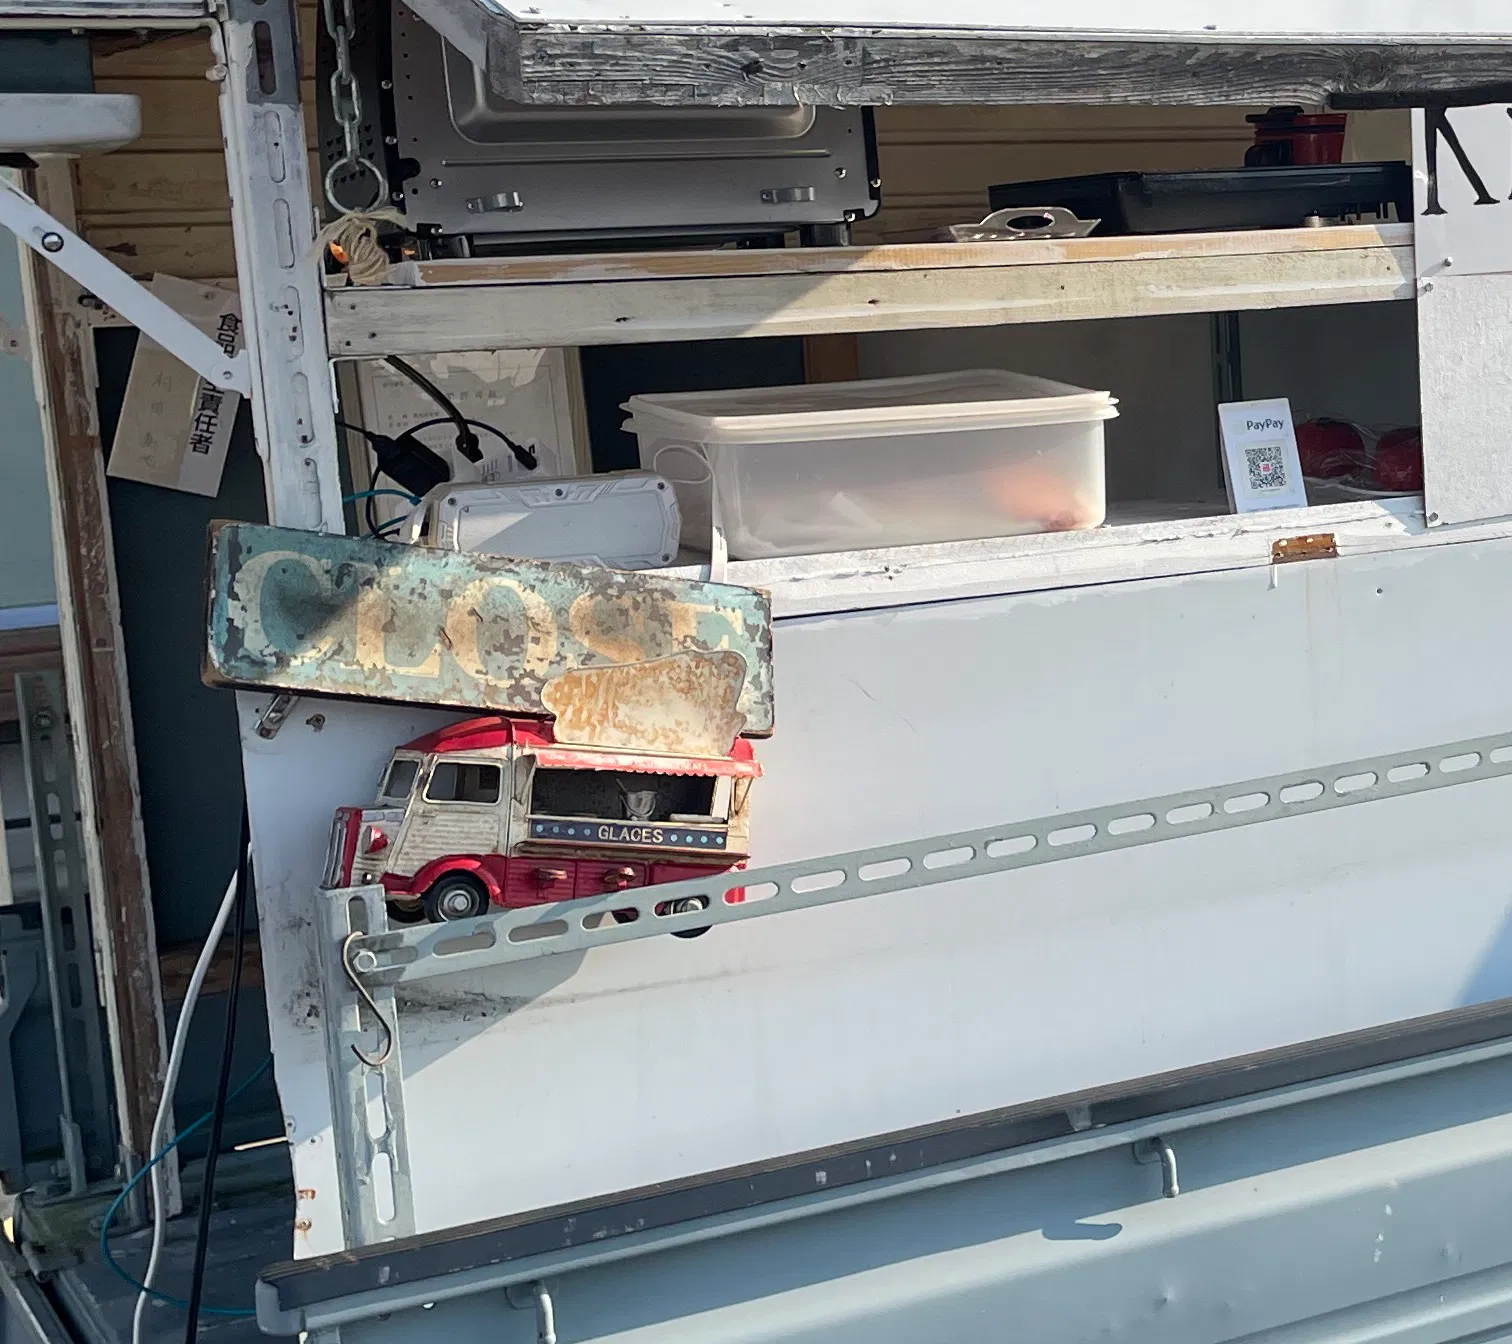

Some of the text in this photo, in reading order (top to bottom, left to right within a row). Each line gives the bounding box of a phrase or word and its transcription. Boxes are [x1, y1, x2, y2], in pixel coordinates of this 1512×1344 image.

[189, 312, 242, 456] 食品責任者
[1246, 418, 1285, 433] PayPay
[597, 824, 665, 844] GLACES
